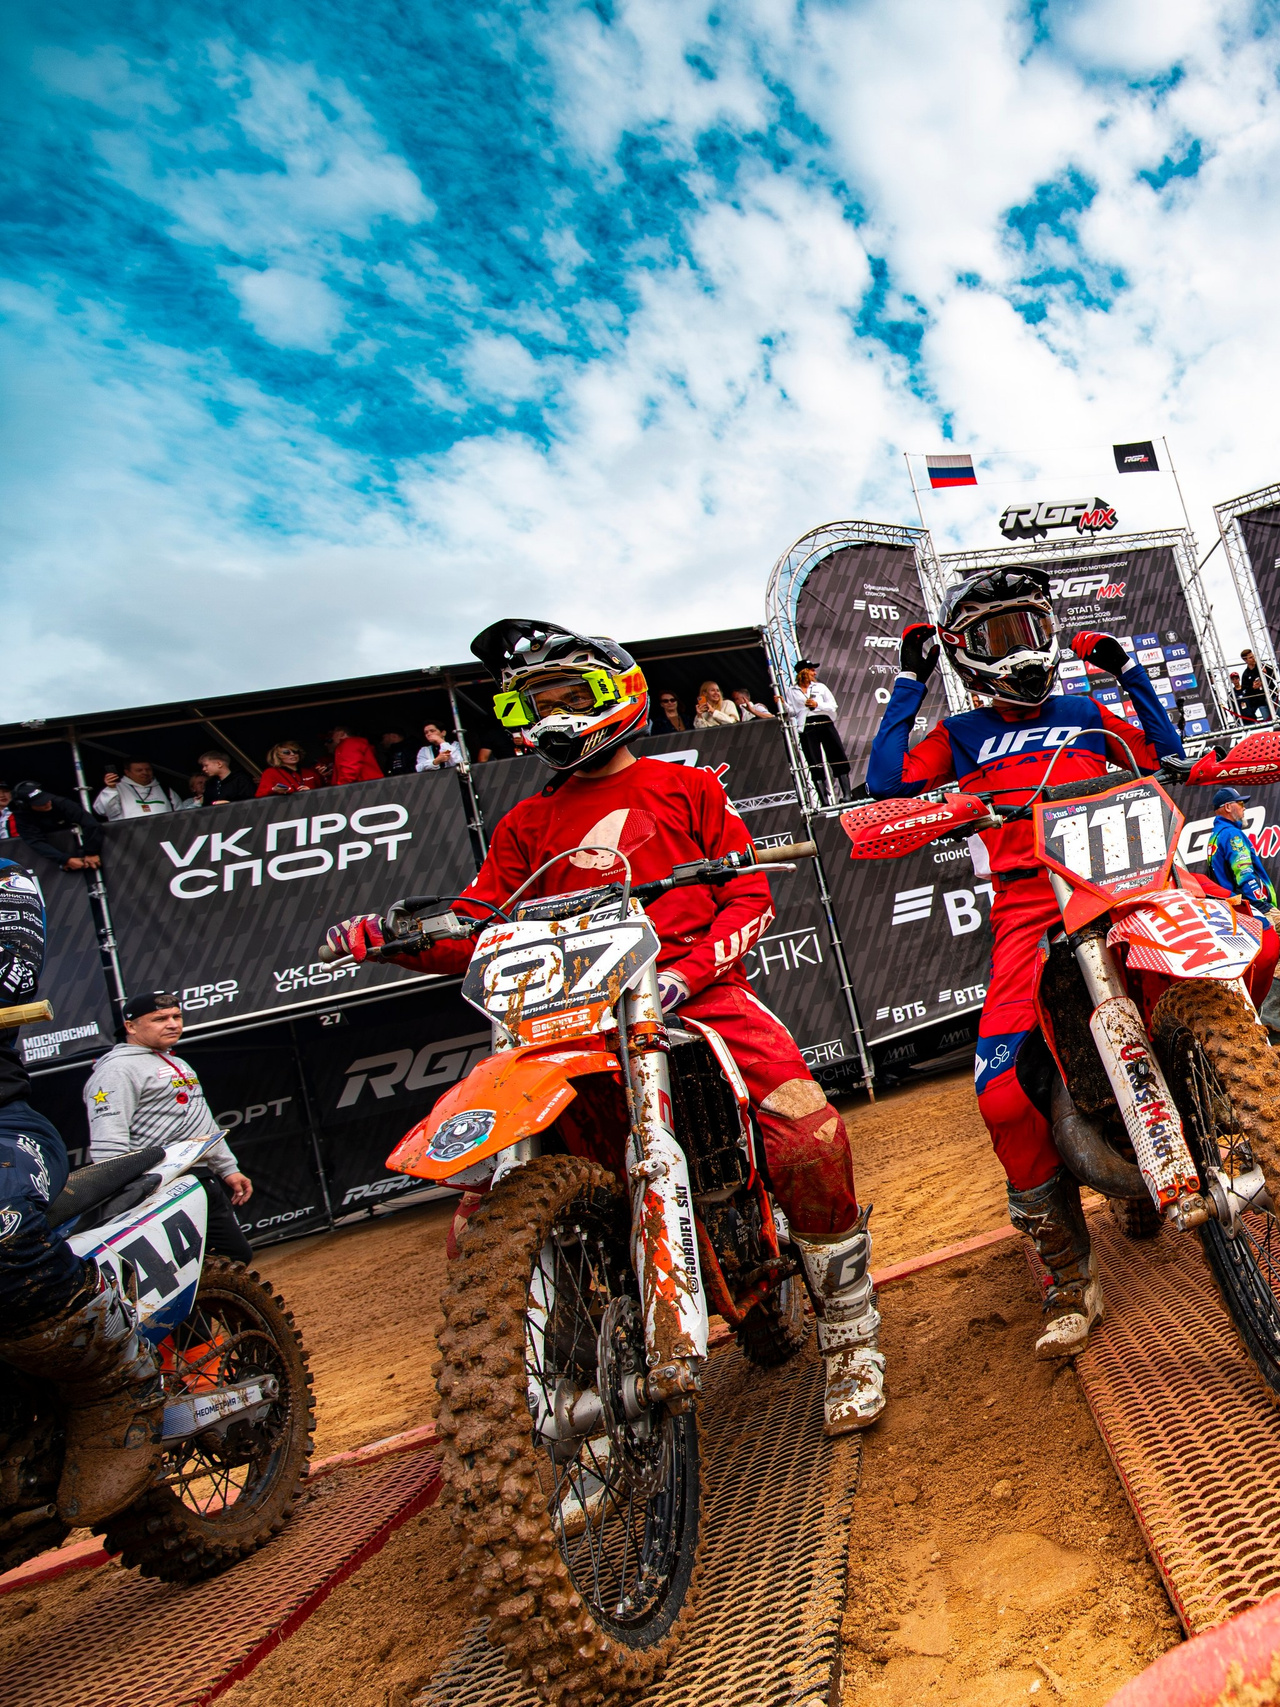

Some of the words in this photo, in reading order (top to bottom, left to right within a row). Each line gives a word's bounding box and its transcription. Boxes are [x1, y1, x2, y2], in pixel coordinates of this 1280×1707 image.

[1004, 497, 1096, 530] RGP
[1079, 508, 1115, 529] MX
[1048, 573, 1110, 600] RGP
[1096, 582, 1127, 601] MX
[868, 604, 900, 620] ВТБ
[1067, 605, 1092, 615] ЭТАП
[1142, 637, 1156, 646] ВТБ
[1172, 648, 1186, 657] ВТБ
[1103, 692, 1117, 701] ВТБ
[977, 726, 1082, 764] UFO
[981, 752, 1080, 779] PLAST
[1216, 763, 1278, 778] ACERBIS
[1116, 788, 1144, 801] RGP
[1067, 805, 1088, 814] Moto
[880, 811, 953, 834] ACERBIS
[160, 827, 254, 868] VK
[266, 803, 409, 852] ПРО
[1050, 796, 1167, 880] 111
[169, 833, 413, 899] СПОРТ
[933, 847, 971, 863] спонс
[942, 882, 995, 937] ВТ
[477, 931, 514, 952] KTM
[746, 933, 823, 981] CHKI
[273, 965, 305, 982] VK
[275, 966, 361, 993] СПОРТ
[483, 928, 643, 1011] 97
[179, 990, 239, 1011] ОРТ
[183, 980, 238, 1000] ПРО
[954, 984, 987, 1005] ВТБ
[320, 1012, 342, 1026] 27
[892, 1001, 927, 1023] ВТБ
[22, 1021, 99, 1049] МОСКОВСКИЙ
[25, 1044, 61, 1061] СПОРТ
[801, 1042, 844, 1066] CHKI
[336, 1030, 493, 1109] RG
[214, 1096, 292, 1130] ОРТ
[256, 1206, 315, 1229] СПОРТ
[676, 1185, 697, 1276] GORDIEV_SKI
[99, 1209, 203, 1299] 44
